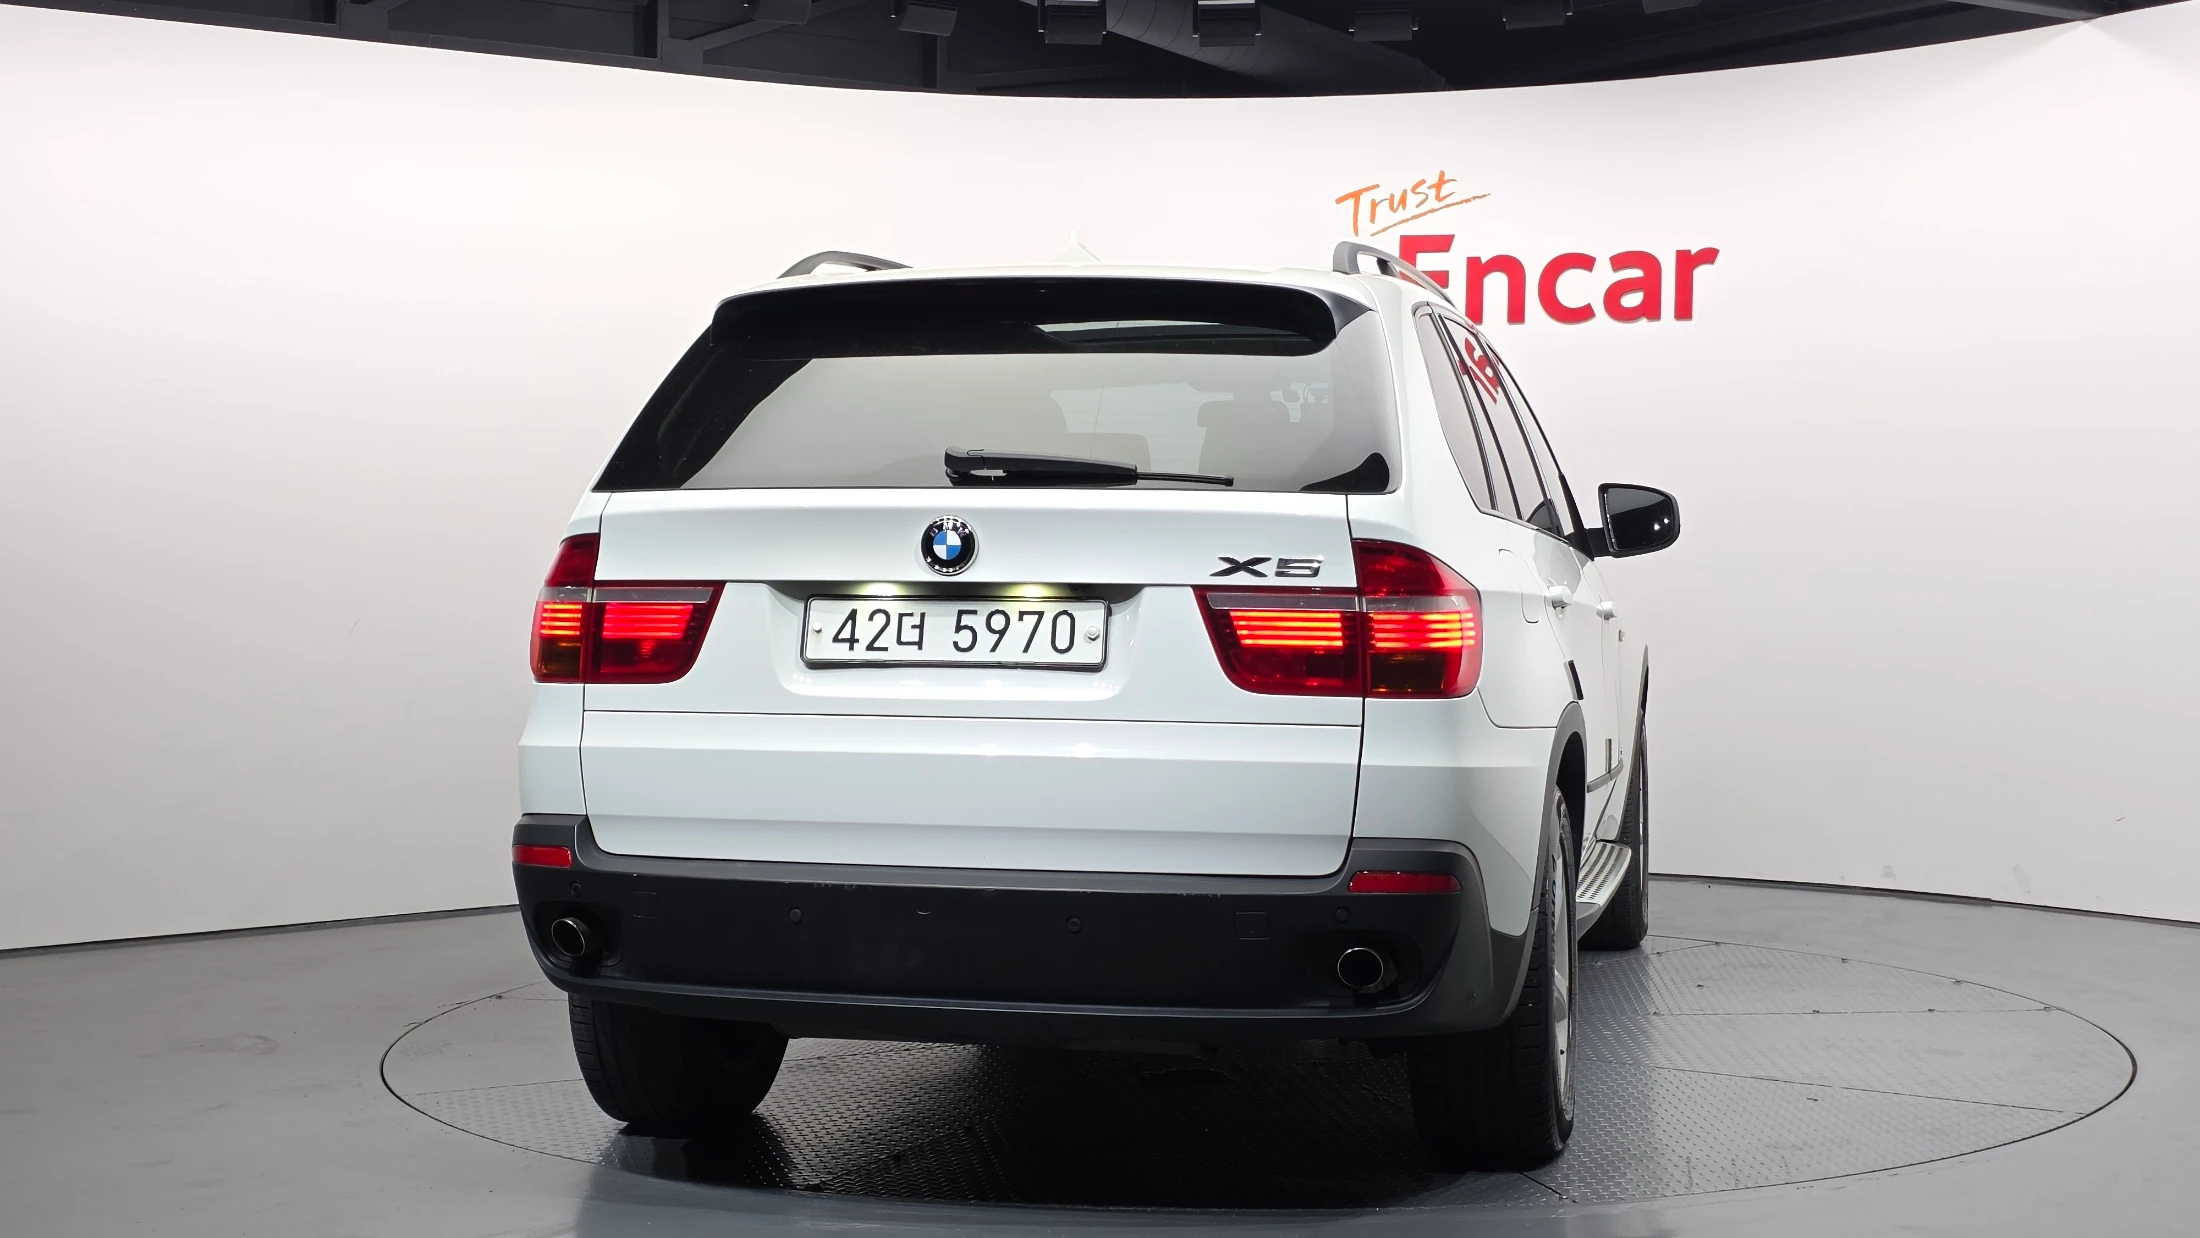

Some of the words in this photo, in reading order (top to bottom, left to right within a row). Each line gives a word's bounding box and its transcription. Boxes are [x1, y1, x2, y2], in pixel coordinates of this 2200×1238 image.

[1335, 170, 1459, 237] Trust
[1399, 234, 1720, 326] Encar
[1209, 556, 1324, 578] X5
[832, 608, 926, 652] 42더
[952, 609, 1076, 654] 5970
